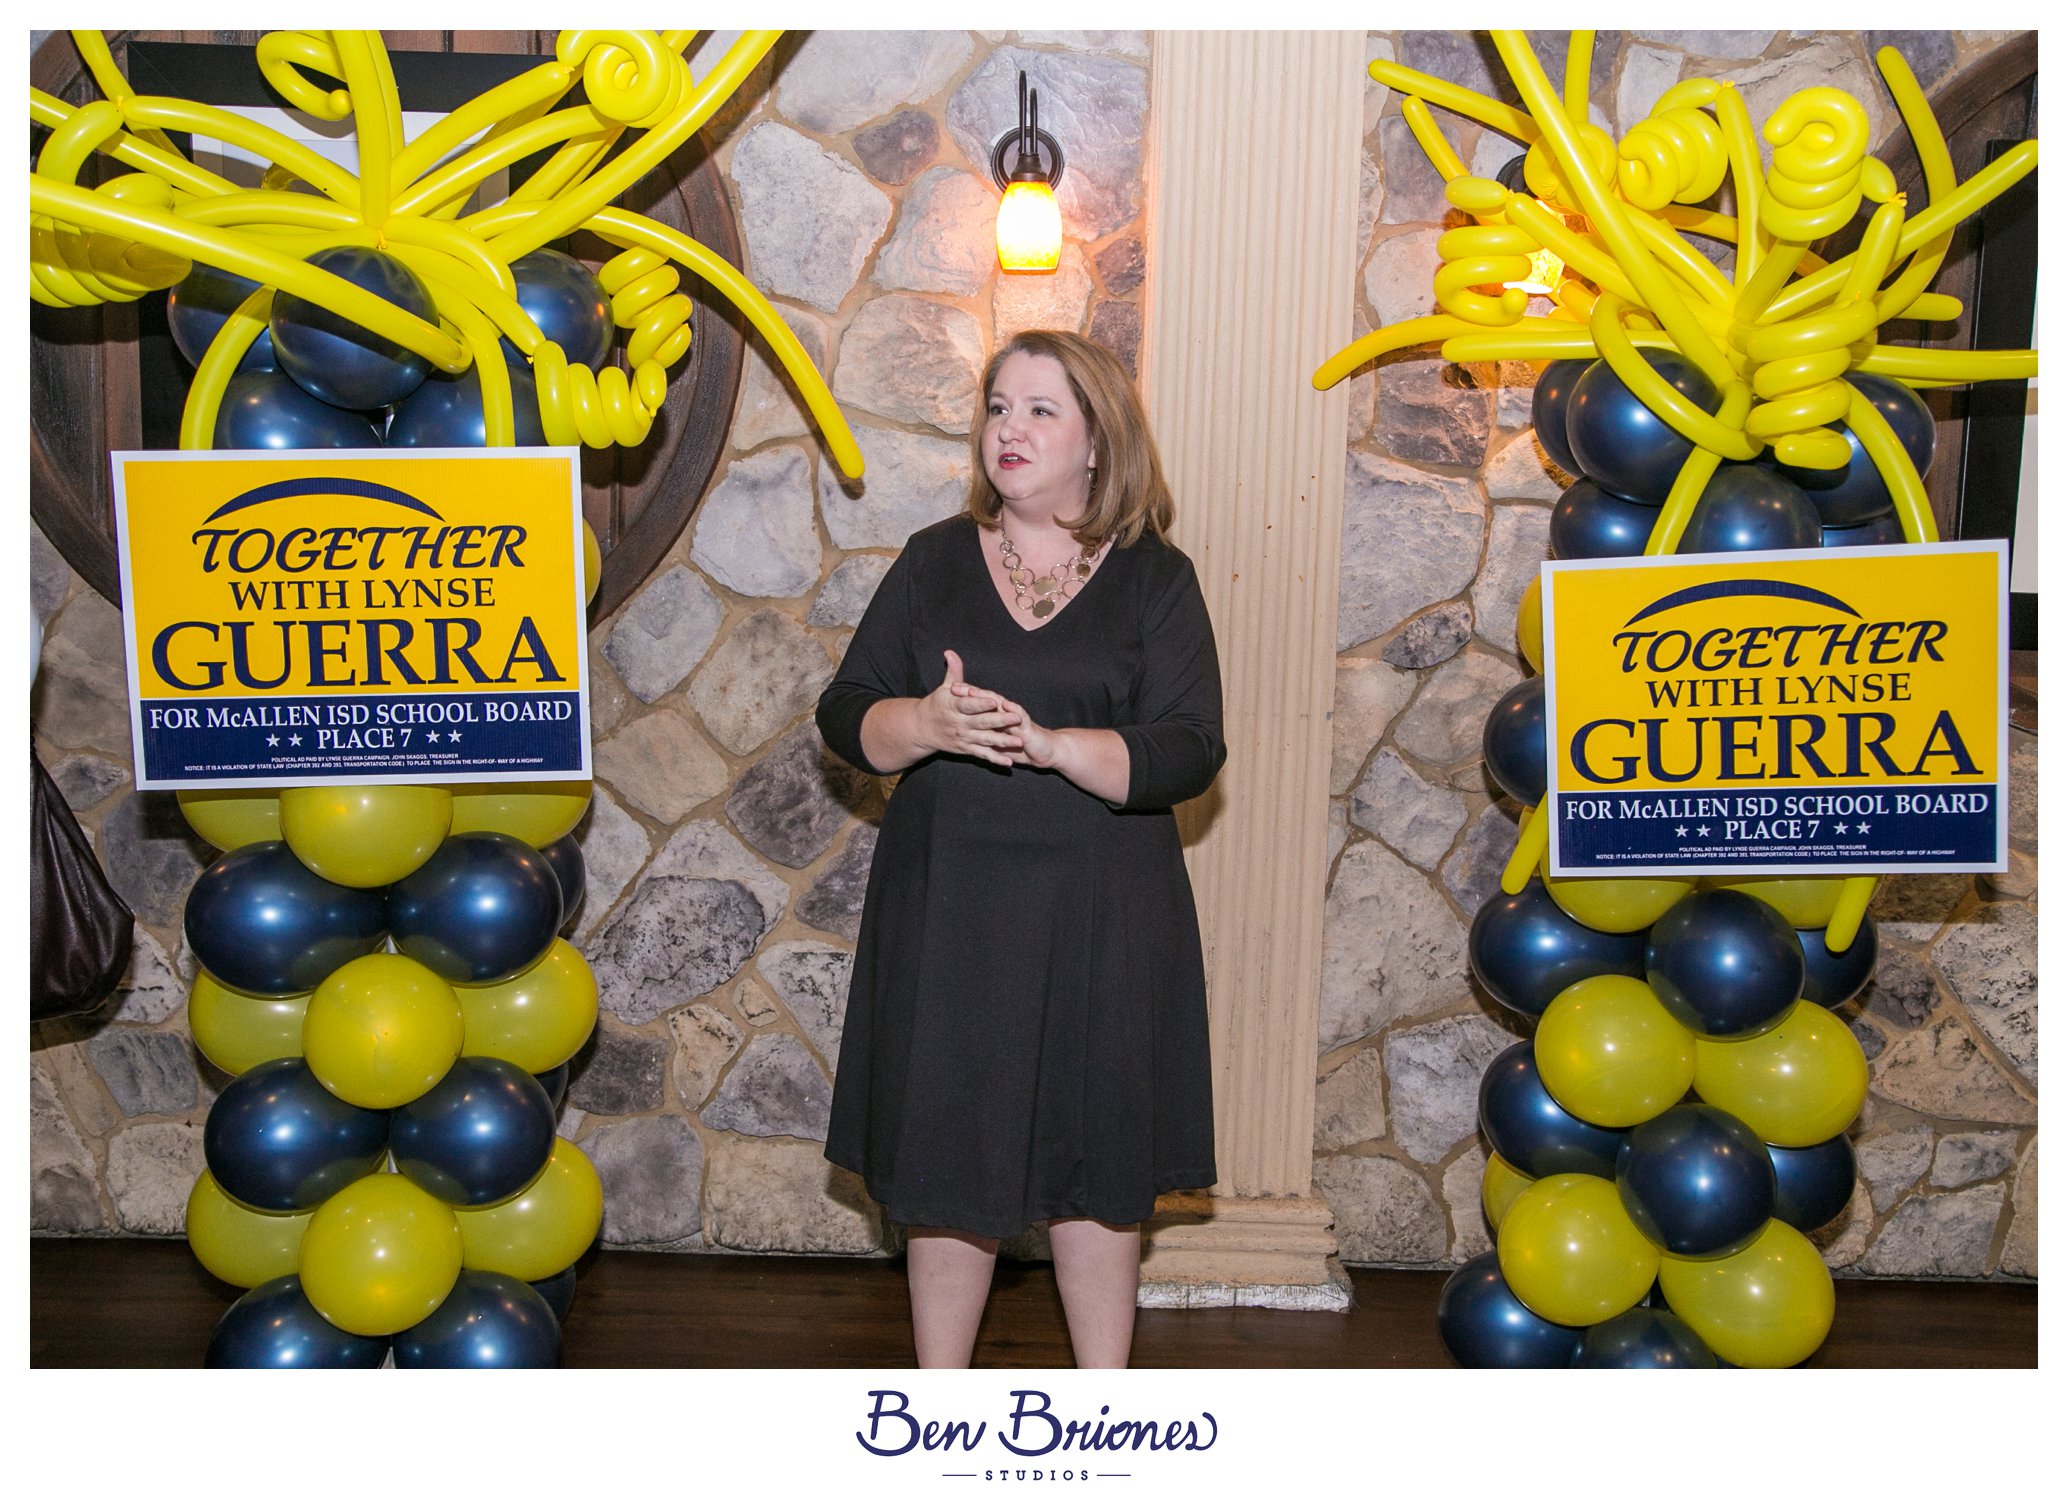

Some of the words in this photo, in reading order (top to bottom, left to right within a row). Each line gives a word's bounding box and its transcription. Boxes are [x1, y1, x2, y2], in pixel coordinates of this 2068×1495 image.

[192, 525, 527, 573] TOGETHER
[228, 580, 350, 610] WITH
[362, 578, 495, 608] LYNSE
[151, 616, 566, 691] GUERRA
[1612, 620, 1948, 673] TOGETHER
[1646, 678, 1762, 708] WITH
[1775, 673, 1911, 704] LYNSE
[149, 708, 202, 729] FOR
[206, 705, 321, 728] McALLEN
[326, 704, 370, 726] ISD
[376, 702, 479, 725] SCHOOL
[483, 700, 572, 722] BOARD
[316, 727, 395, 750] PLACE
[400, 728, 413, 748] 7
[1569, 710, 1983, 785] GUERRA
[1565, 800, 1614, 820] FOR
[1618, 797, 1730, 819] McALLEN
[1735, 797, 1778, 817] ISD
[1784, 794, 1890, 817] SCHOOL
[1895, 793, 1989, 814] BOARD
[1724, 819, 1802, 840] PLACE
[1807, 820, 1820, 839] 7
